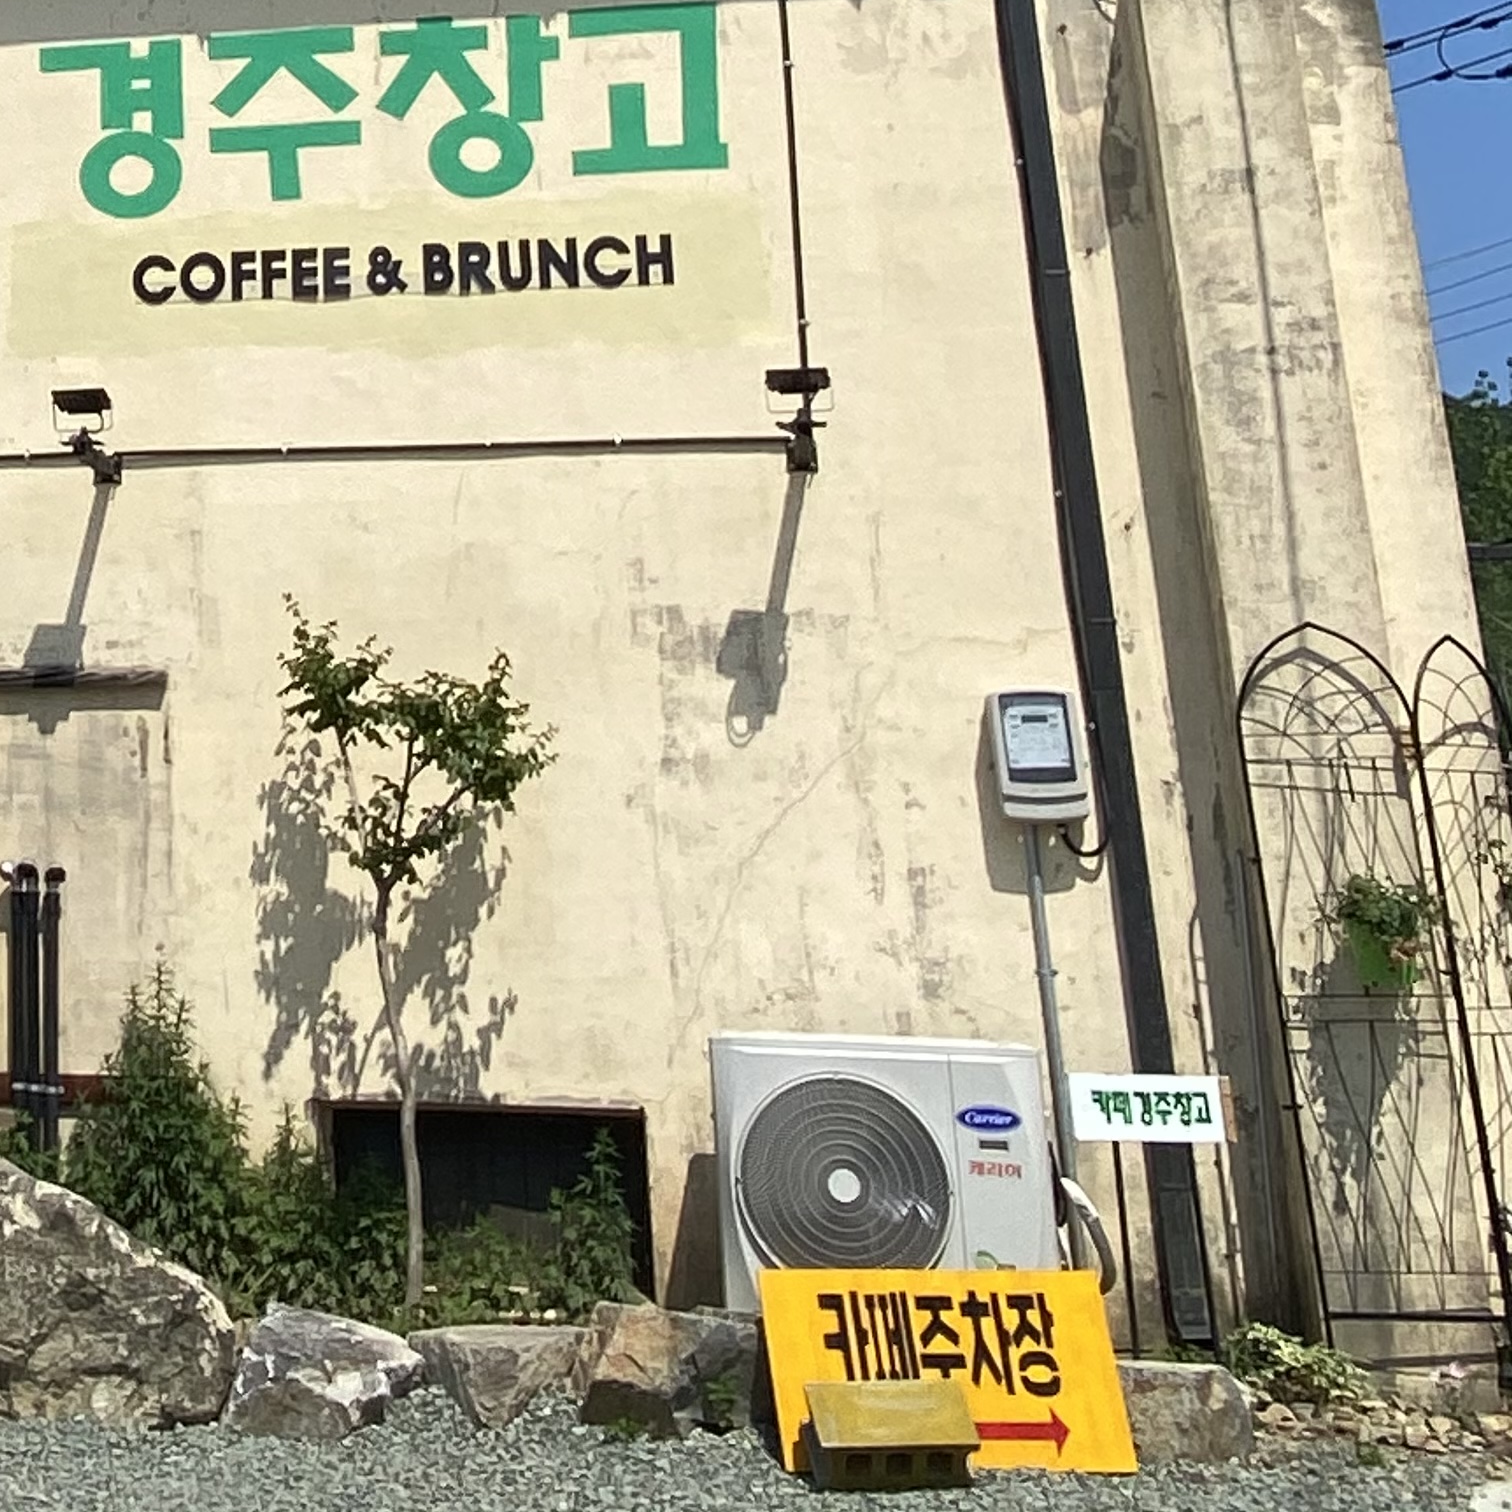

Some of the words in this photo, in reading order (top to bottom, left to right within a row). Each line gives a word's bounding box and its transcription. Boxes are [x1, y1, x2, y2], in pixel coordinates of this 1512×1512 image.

[39, 0, 730, 219] 경주창고
[133, 246, 351, 305] COFFEE
[367, 245, 408, 296] &
[422, 233, 675, 297] BRUNCH
[964, 1111, 1013, 1125] Carrier
[817, 1290, 1061, 1397] 카페주차장
